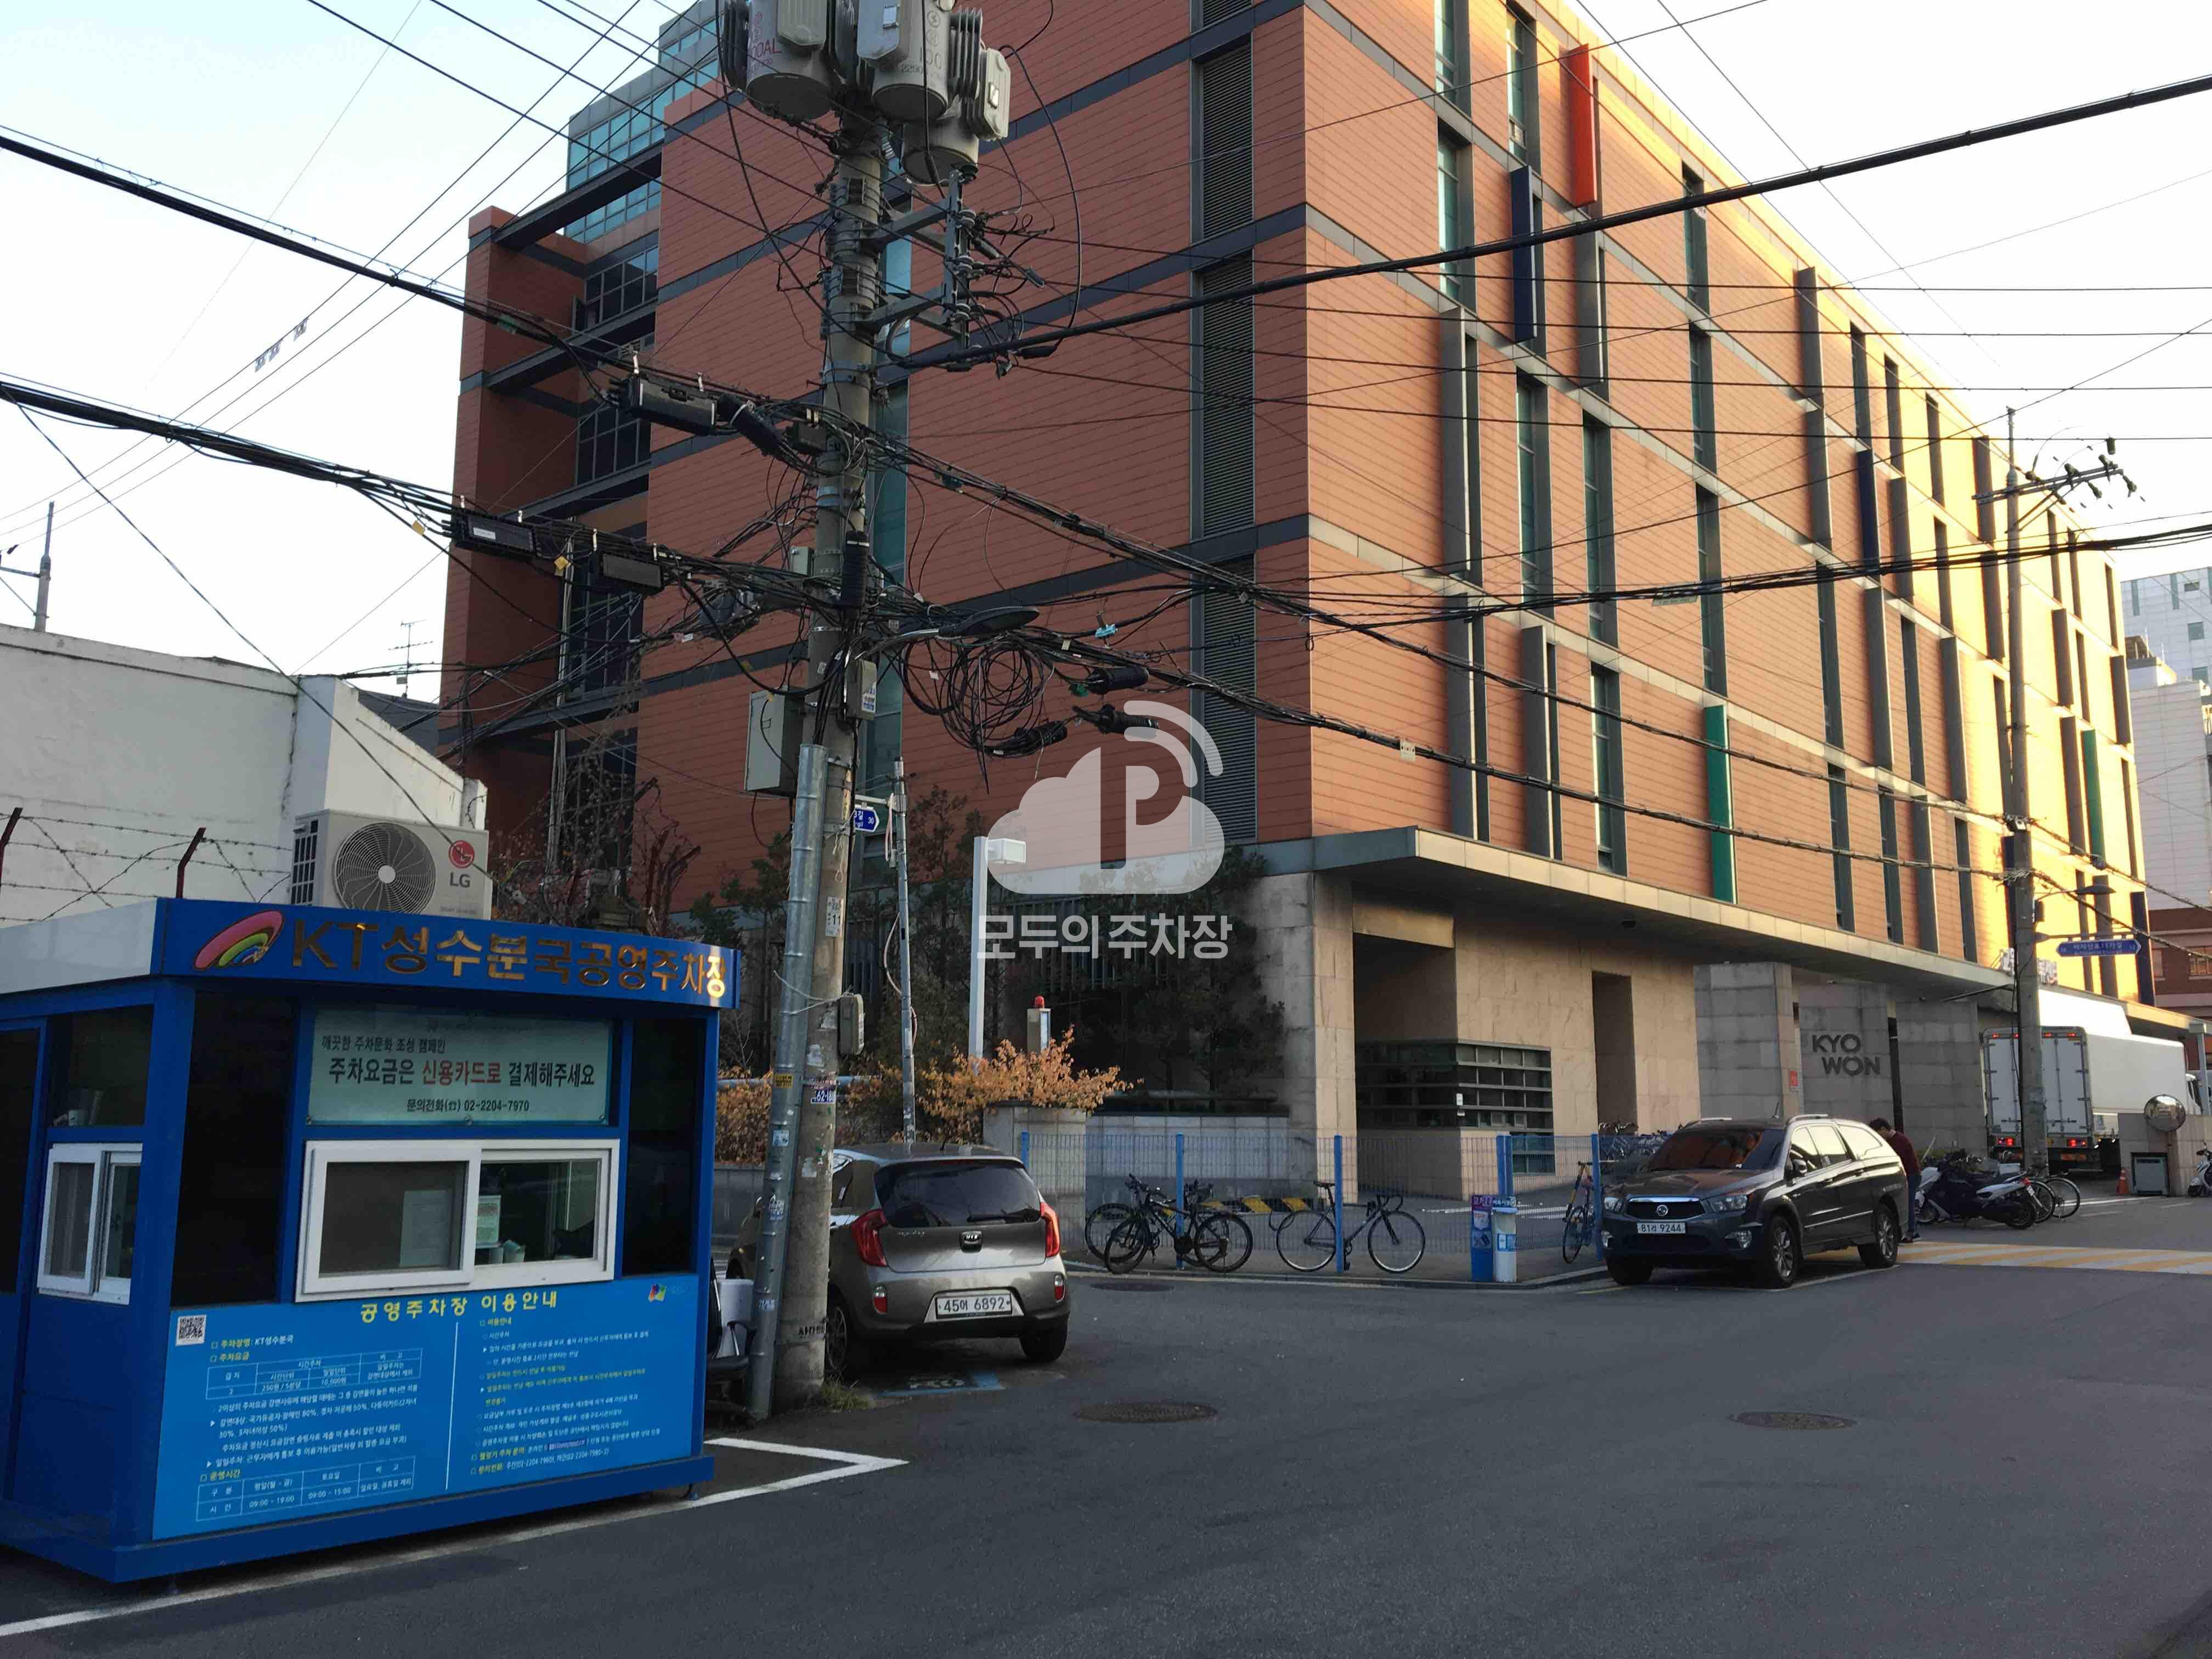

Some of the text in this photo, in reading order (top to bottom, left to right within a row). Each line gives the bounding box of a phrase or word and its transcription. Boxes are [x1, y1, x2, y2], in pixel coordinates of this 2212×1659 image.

[449, 872, 470, 888] LG
[322, 1035, 446, 1054] 깨끗한 주차문화 조성 캠페인
[1812, 1034, 1861, 1053] KYO
[329, 1057, 595, 1087] 주차요금은 신용카드로 결제해주세요
[1821, 1056, 1881, 1076] WON
[464, 1099, 529, 1112] 02-2204-7970
[1660, 1224, 1681, 1233] 9244
[360, 1290, 557, 1324] 공영주차장 이용안내
[974, 1296, 1006, 1311] 6892
